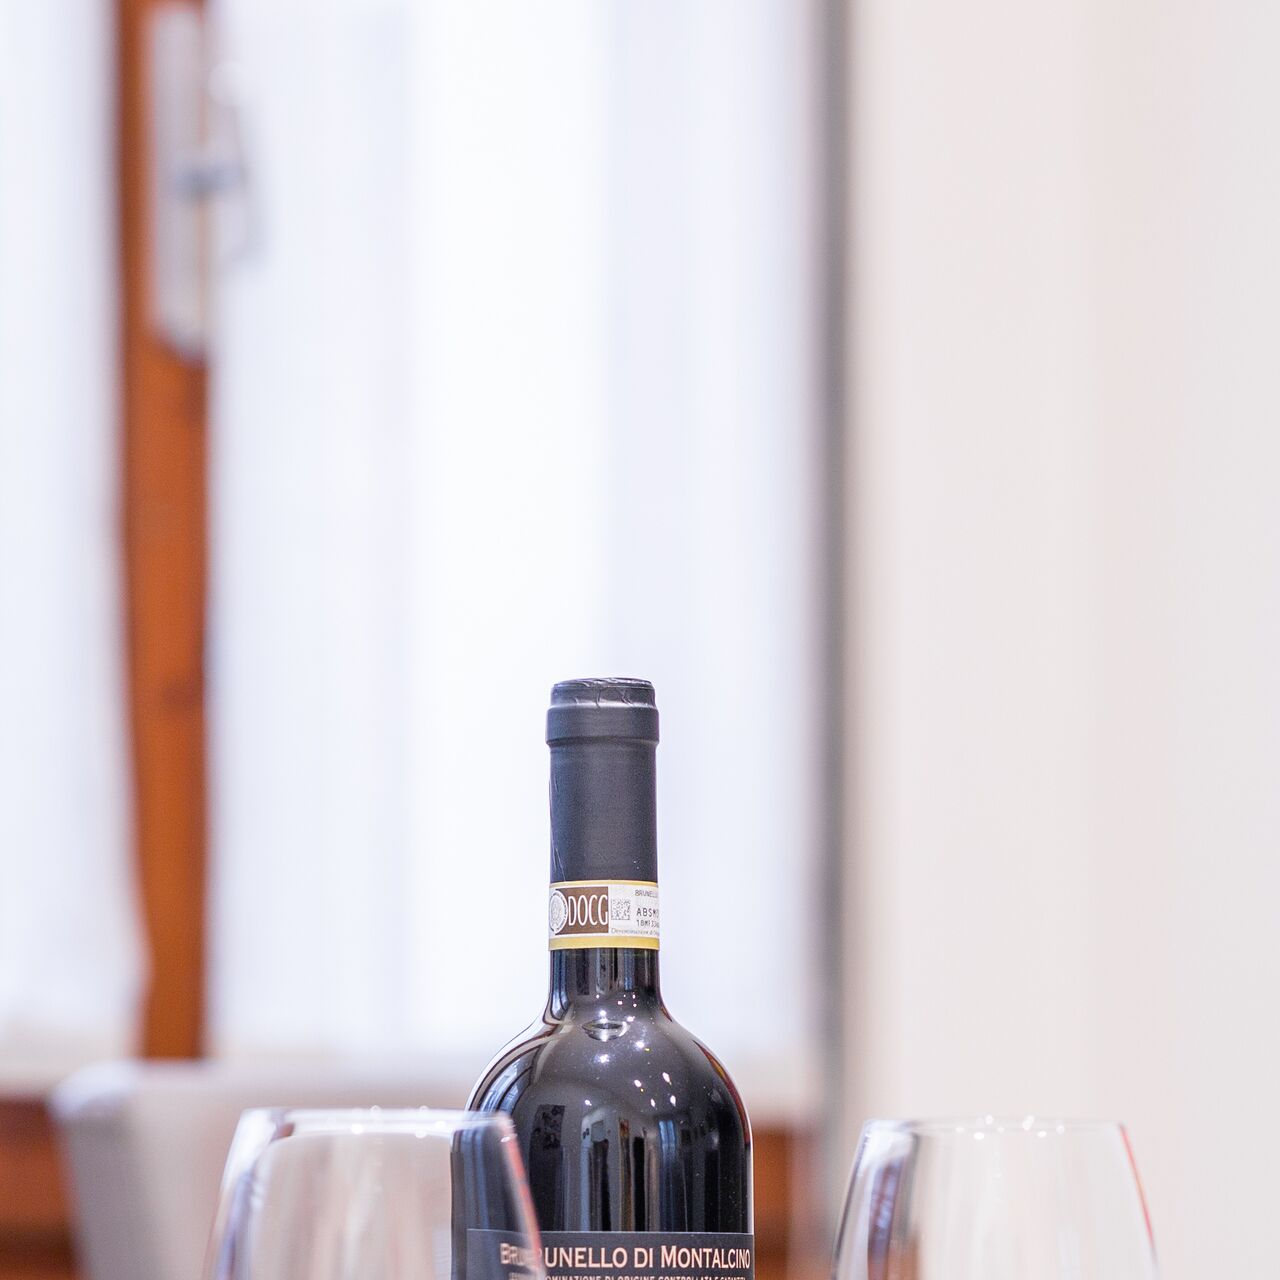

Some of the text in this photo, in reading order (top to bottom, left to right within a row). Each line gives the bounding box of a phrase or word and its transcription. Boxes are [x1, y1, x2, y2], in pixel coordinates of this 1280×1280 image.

[568, 895, 608, 926] DOCG
[634, 1248, 653, 1269] DI
[661, 1245, 751, 1270] MONTALCINO
